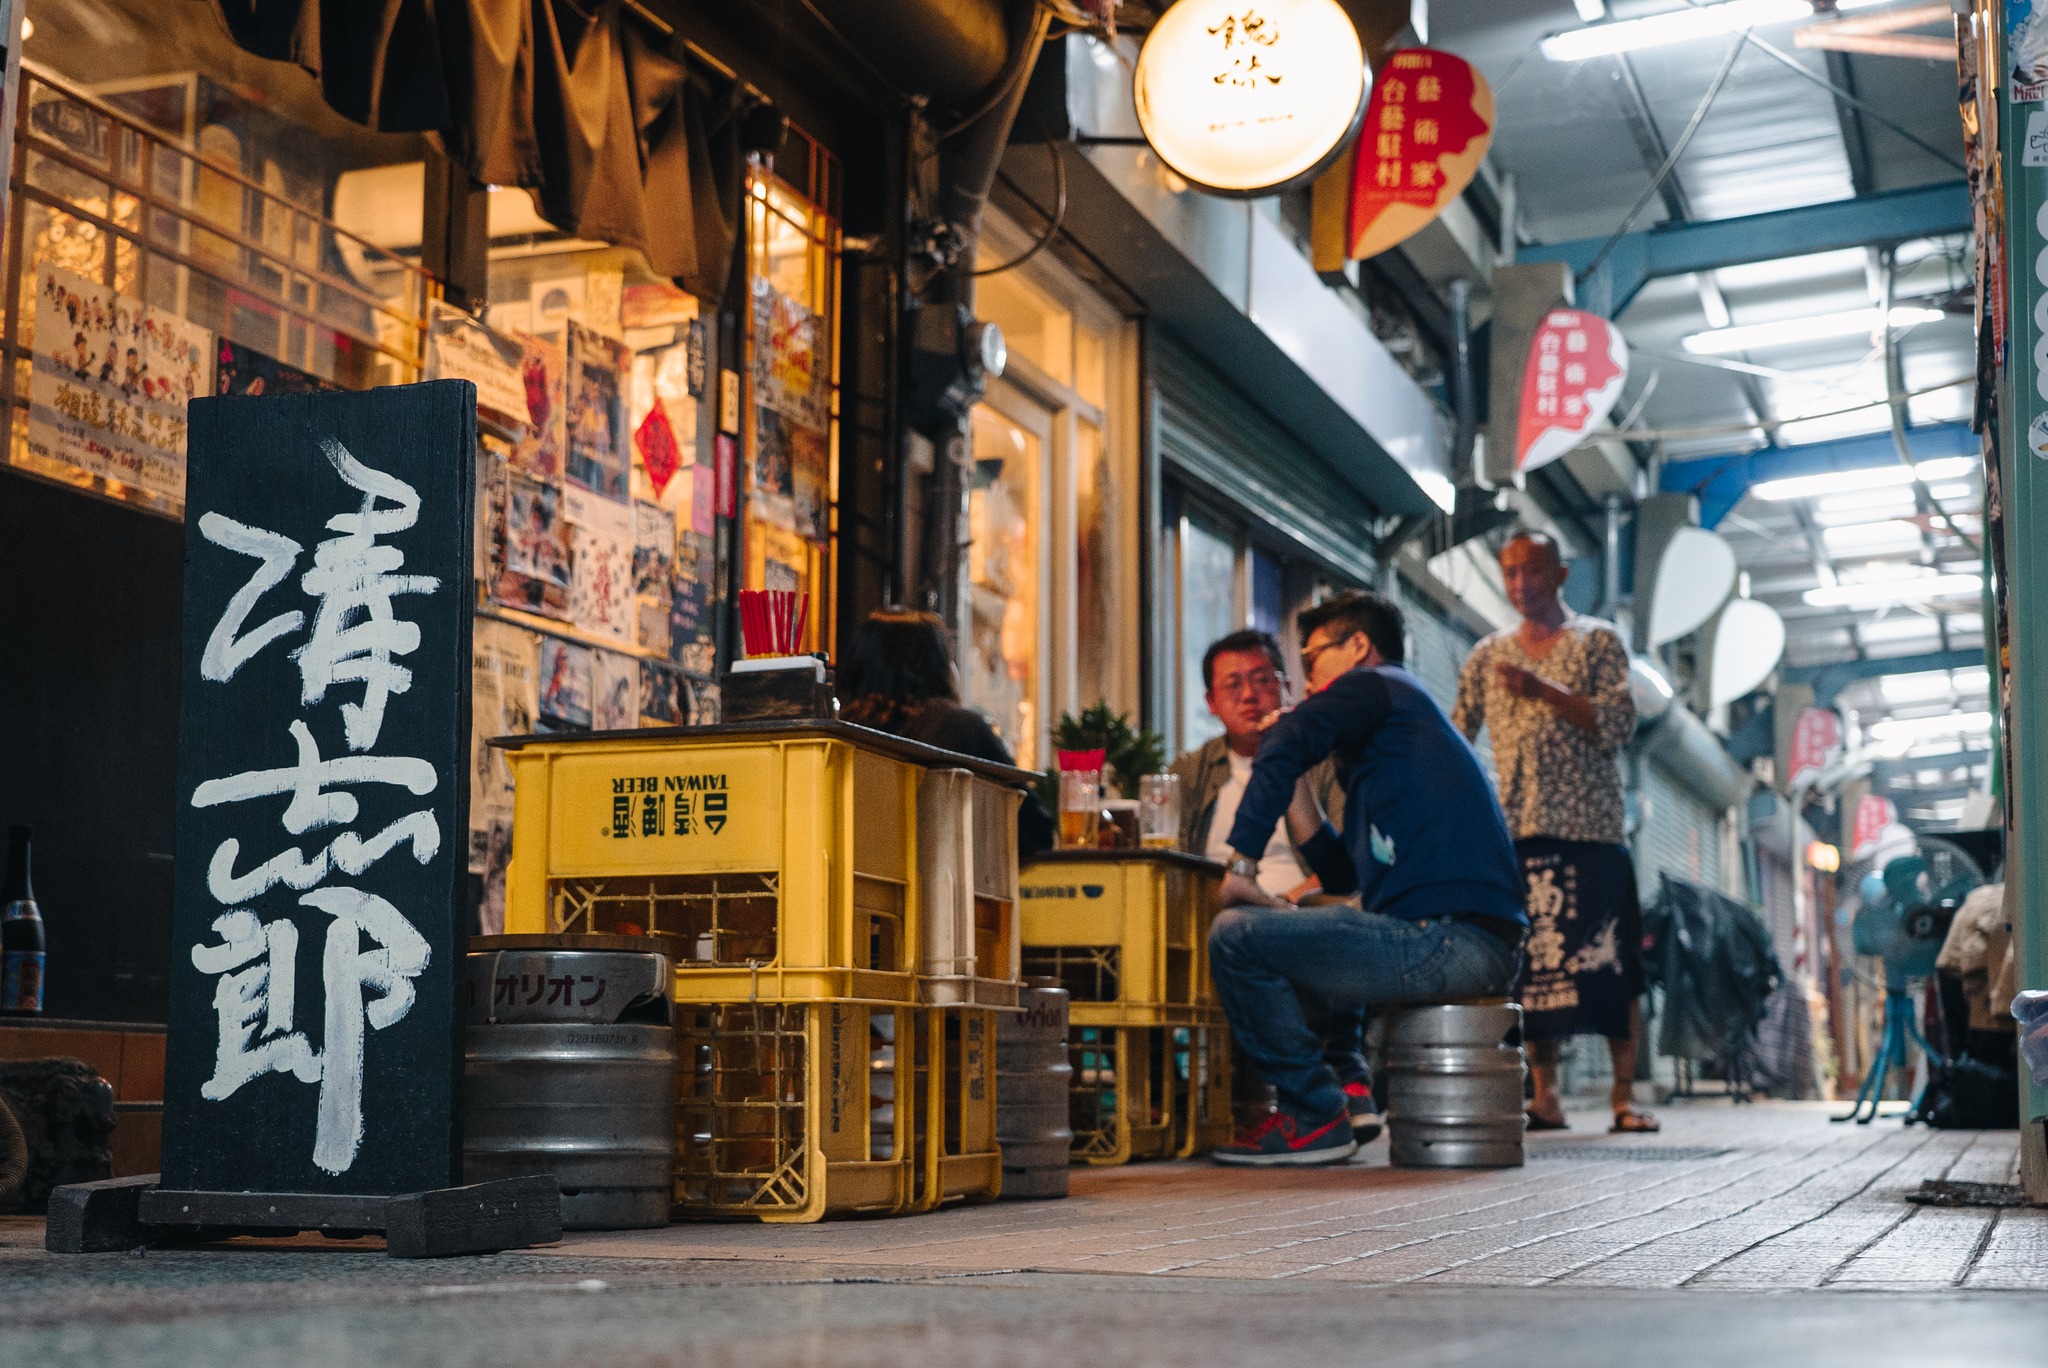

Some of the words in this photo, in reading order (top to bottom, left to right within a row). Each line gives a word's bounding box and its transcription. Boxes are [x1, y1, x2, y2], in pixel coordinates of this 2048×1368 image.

[1375, 76, 1408, 188] 台藝駐村
[1410, 74, 1443, 188] 藝術家
[612, 776, 658, 794] BEER
[665, 774, 729, 792] TAIWAN
[495, 974, 606, 1006] オリオン
